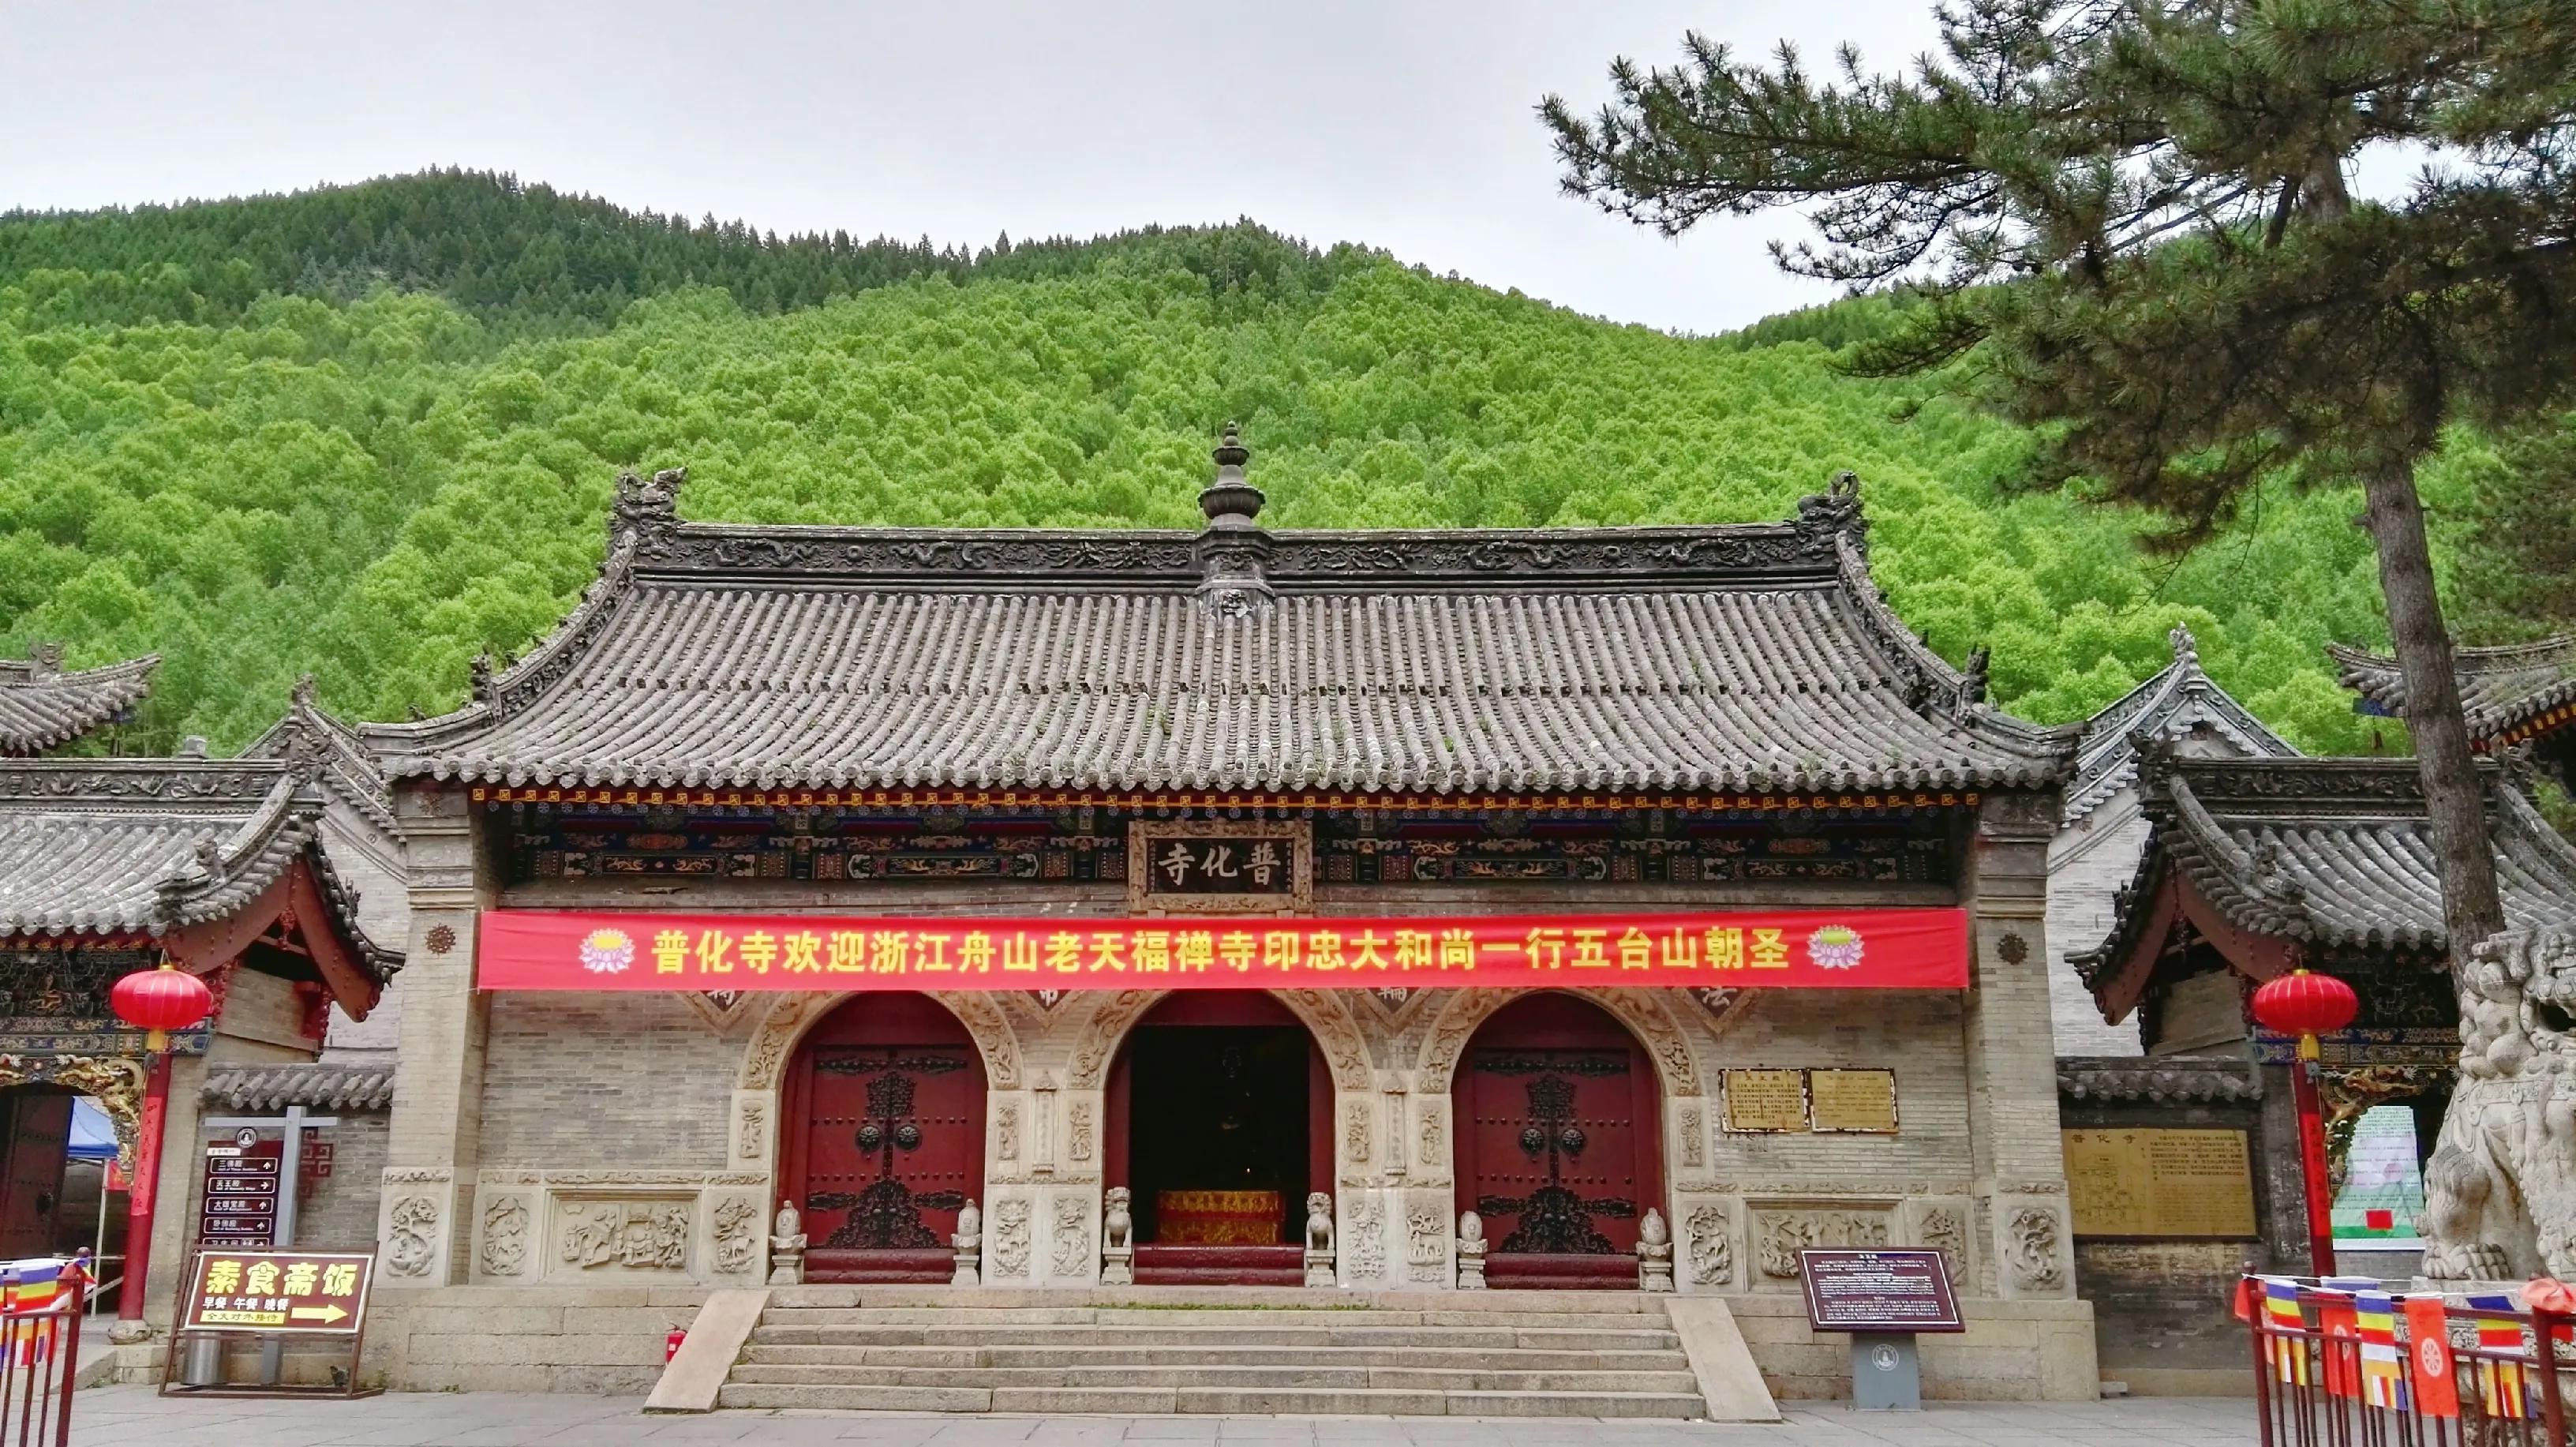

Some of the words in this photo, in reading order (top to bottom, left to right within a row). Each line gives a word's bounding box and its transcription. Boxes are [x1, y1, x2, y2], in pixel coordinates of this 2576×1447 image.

[650, 926, 1789, 974] 普化寺欢迎浙江舟山老天福禅寺印忠大和尚一行五台山朝圣
[205, 1259, 358, 1297] 素食斋饭
[202, 1296, 228, 1310] 早餐
[233, 1297, 259, 1311] 午餐
[264, 1298, 290, 1311] 晚餐
